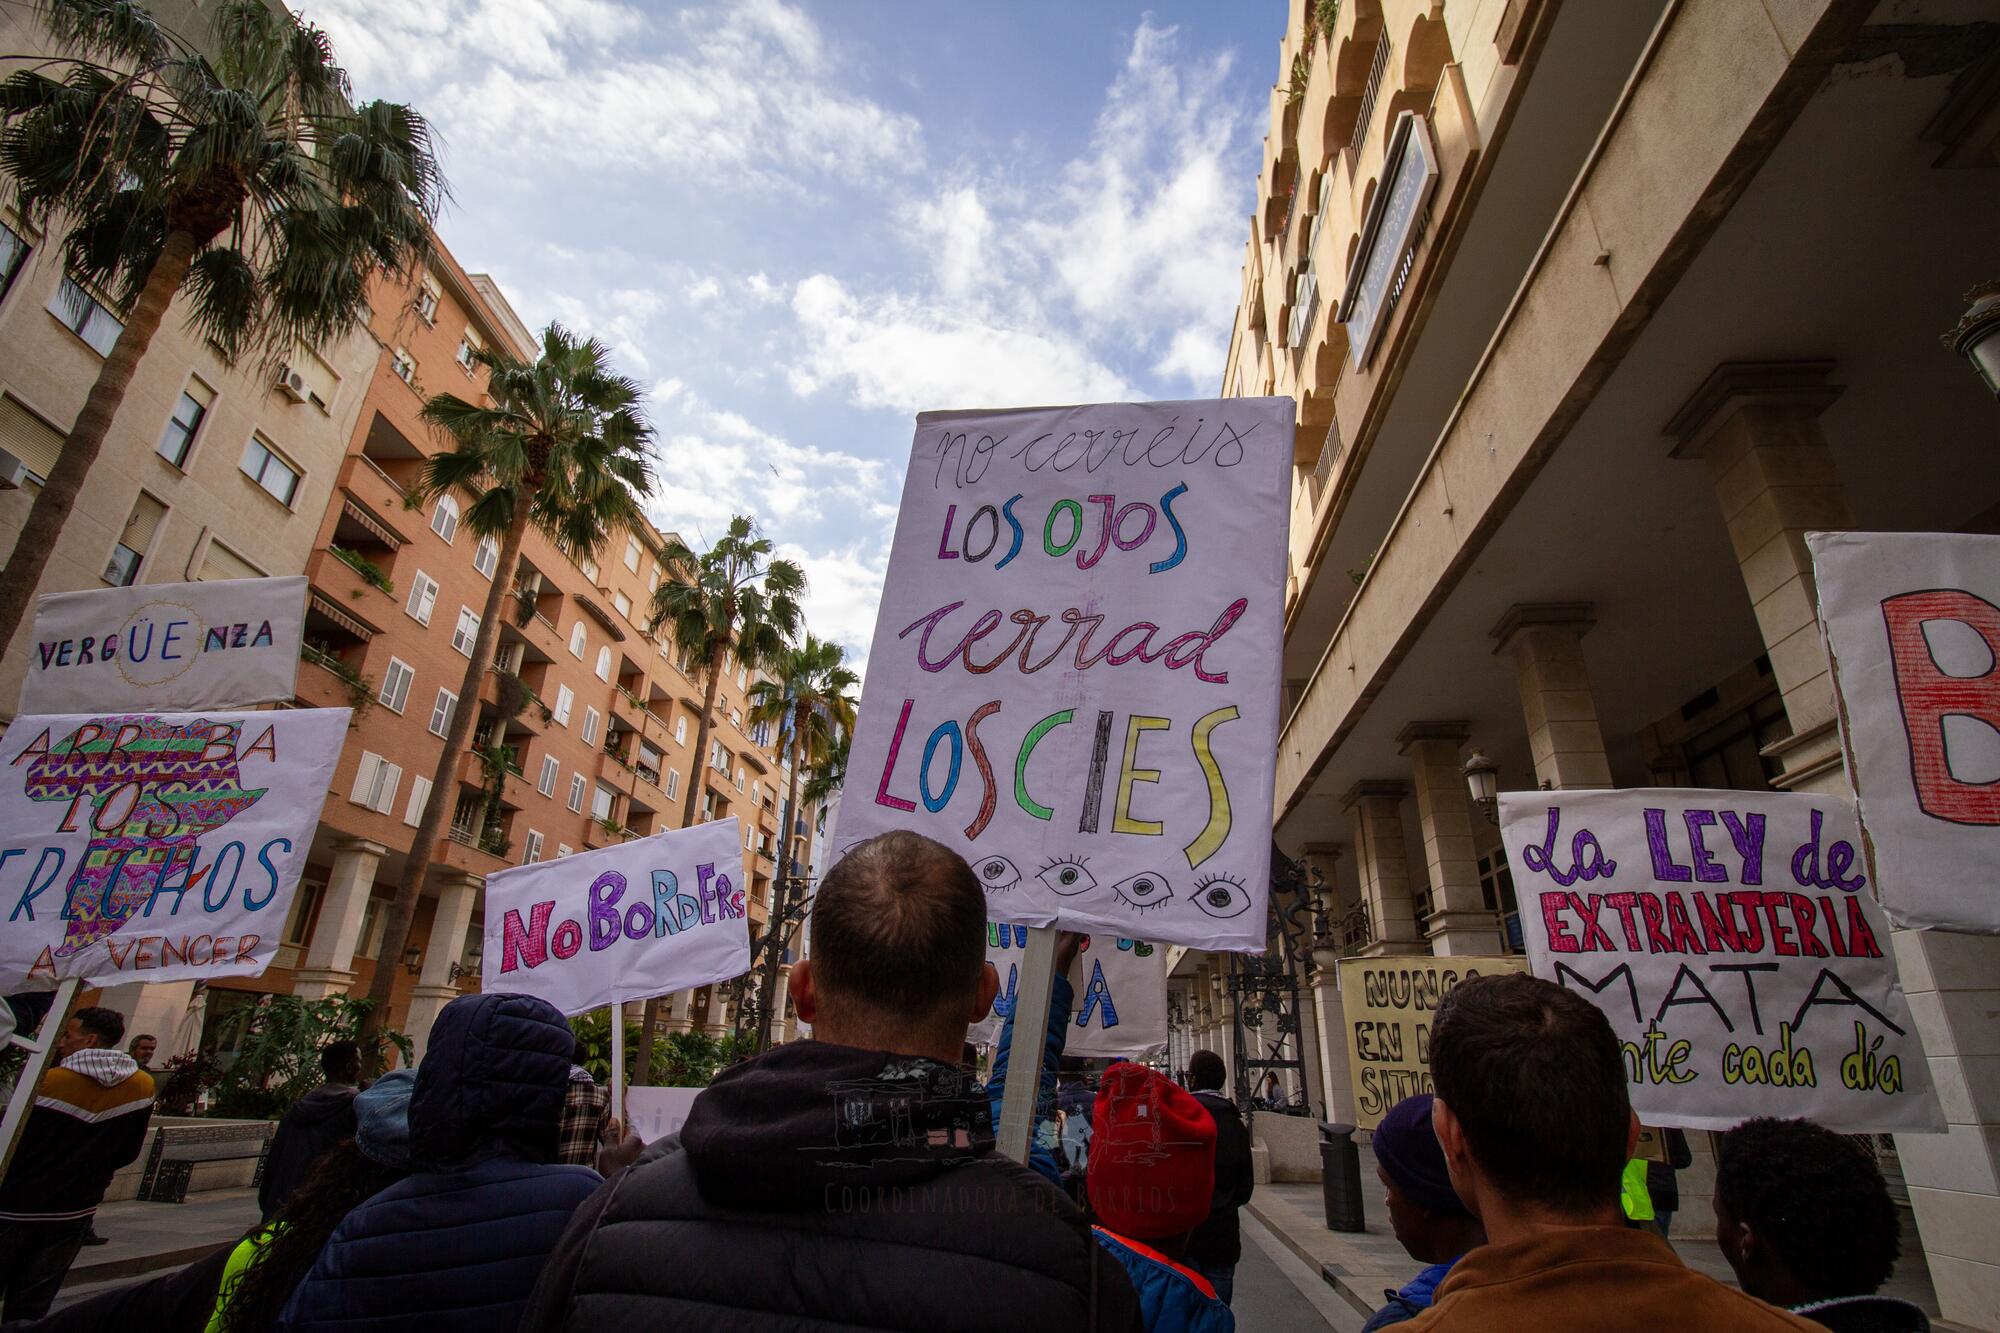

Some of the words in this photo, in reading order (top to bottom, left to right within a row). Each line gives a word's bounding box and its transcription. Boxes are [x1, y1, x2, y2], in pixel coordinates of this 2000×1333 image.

[935, 431, 1008, 489] no
[937, 493, 1024, 570] LOS
[1043, 481, 1189, 574] OJOS
[899, 598, 1249, 684] cerrad
[10, 724, 276, 766] ARRIBA
[56, 780, 191, 838] LOS
[875, 699, 1001, 841] LOS
[1014, 704, 1240, 870] CIES
[1523, 807, 1617, 887] La
[1643, 808, 1766, 885] LEY
[1791, 809, 1865, 892] de
[27, 944, 57, 979] A
[106, 935, 259, 971] VENCER
[1539, 891, 1884, 958] EXTRANJERIA
[1554, 961, 1906, 1036] MATA
[1355, 1022, 1403, 1061] EN
[1619, 1019, 1698, 1085] nte
[1722, 1021, 1817, 1088] cada
[1843, 1021, 1903, 1093] día
